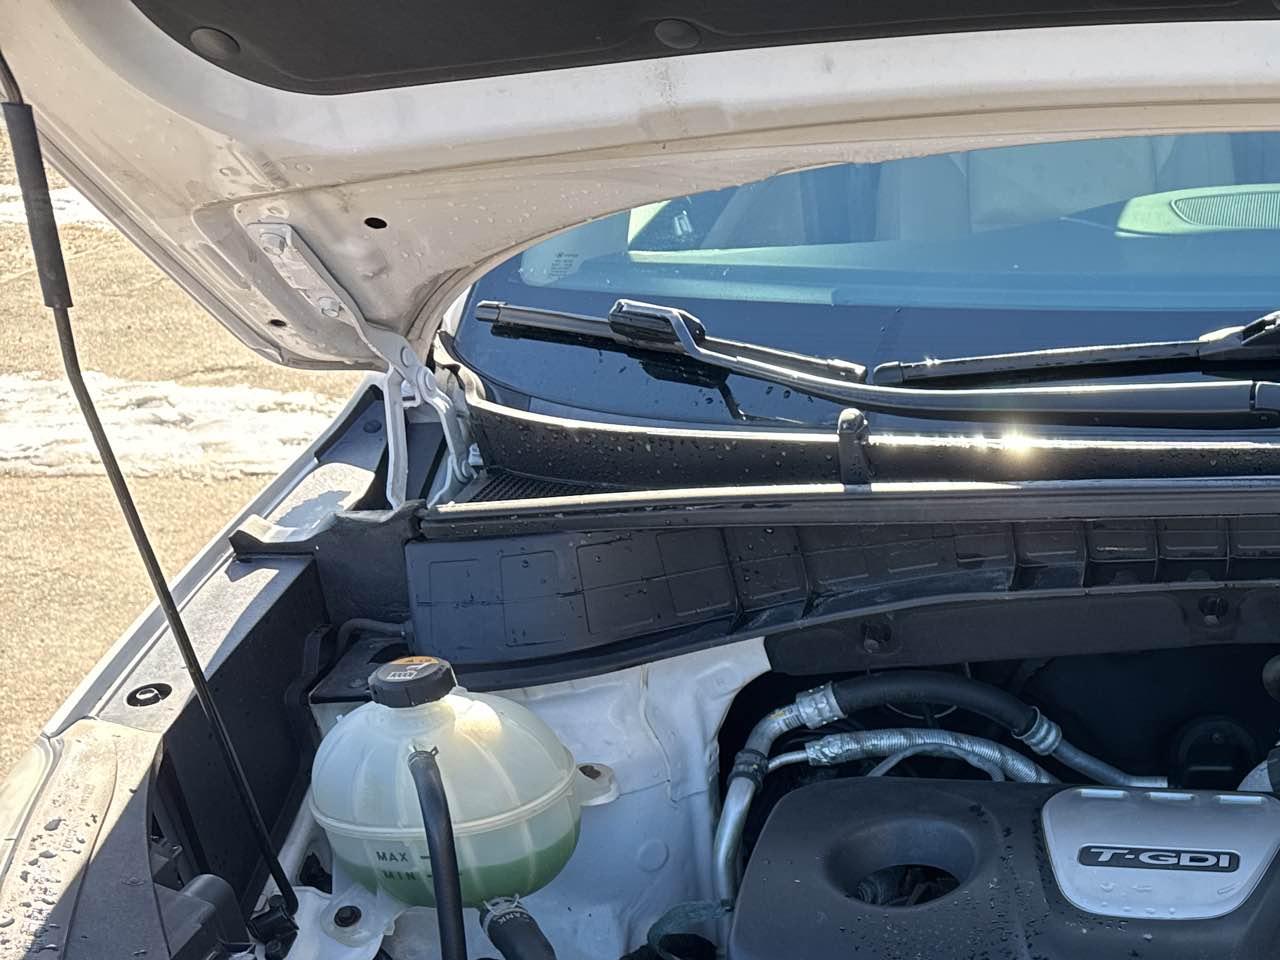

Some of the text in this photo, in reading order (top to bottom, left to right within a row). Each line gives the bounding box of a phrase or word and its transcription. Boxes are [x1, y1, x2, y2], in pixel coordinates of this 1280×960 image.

[376, 850, 409, 863] MAX
[1090, 848, 1232, 868] T-GDI
[382, 870, 417, 881] MIN
